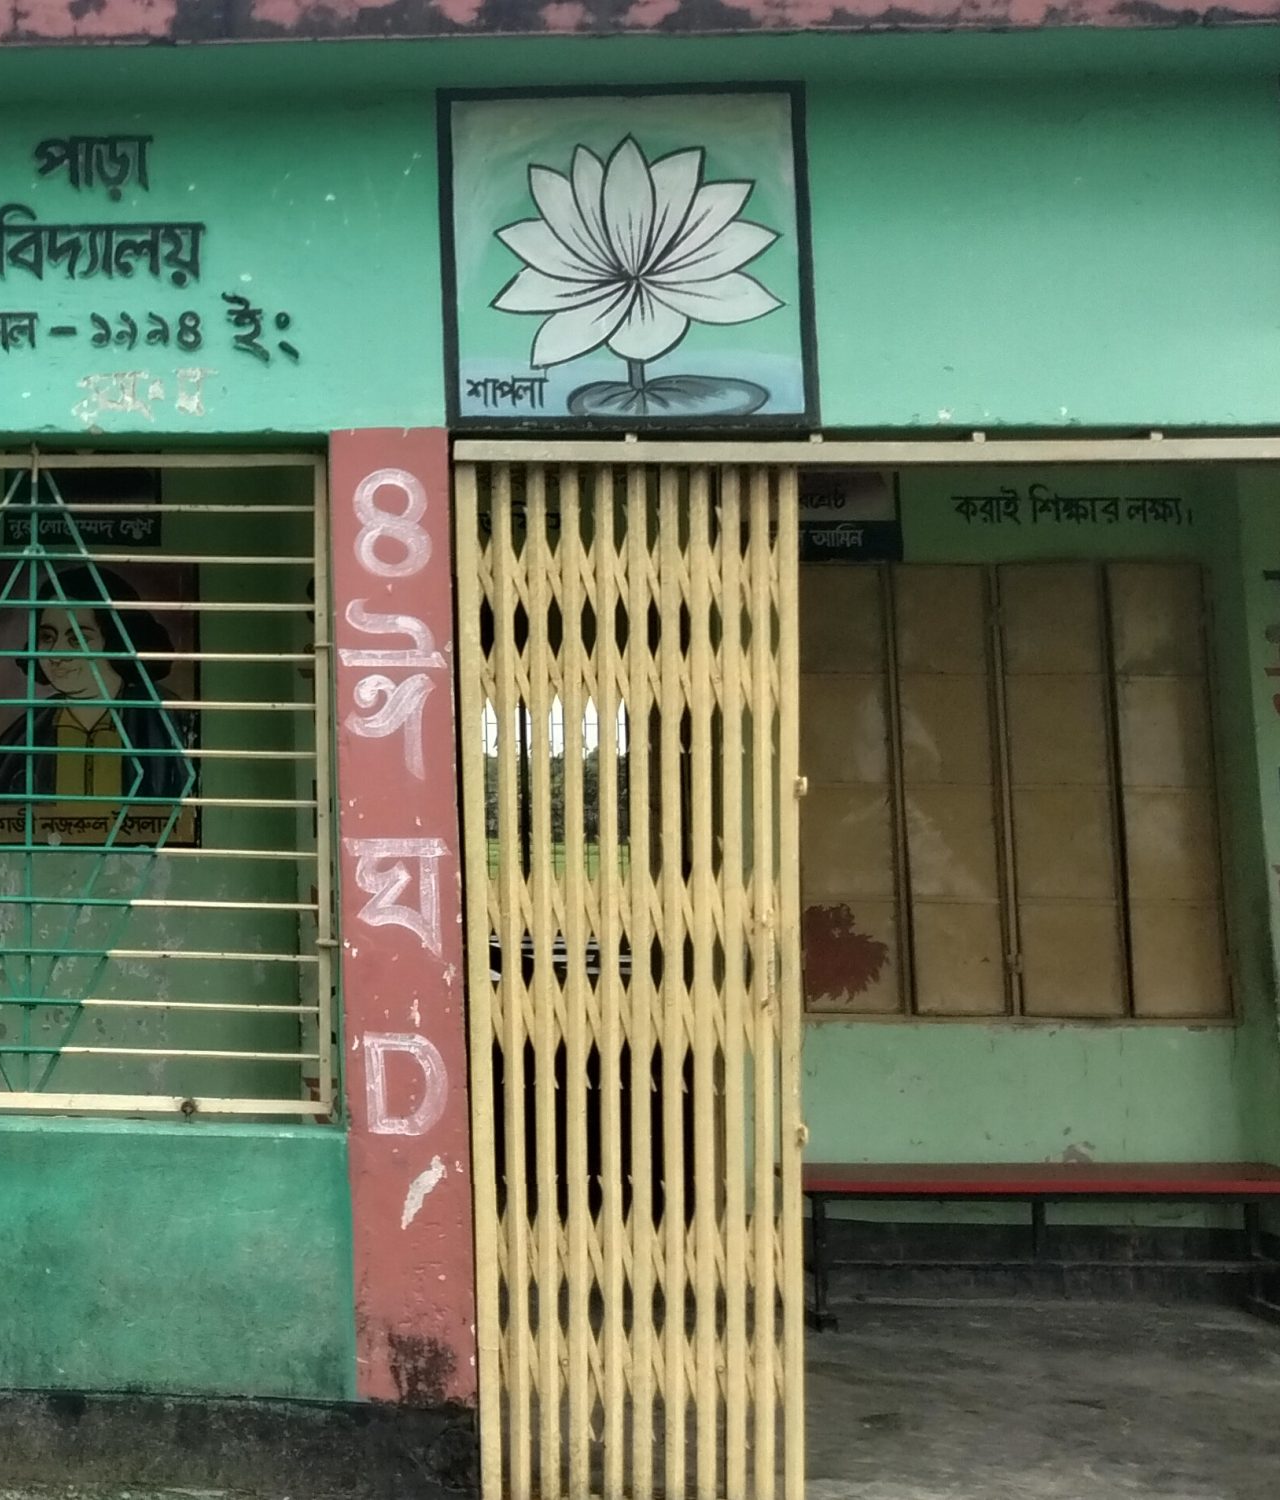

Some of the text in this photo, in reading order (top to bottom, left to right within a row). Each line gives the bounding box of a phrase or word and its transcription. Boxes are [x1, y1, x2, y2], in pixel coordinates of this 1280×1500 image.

[35, 134, 154, 202] পাড়া
[466, 375, 549, 409] শাপলা
[949, 486, 1019, 525] করাই
[1025, 483, 1117, 525] শিক্ষার
[807, 522, 864, 549] আমিন
